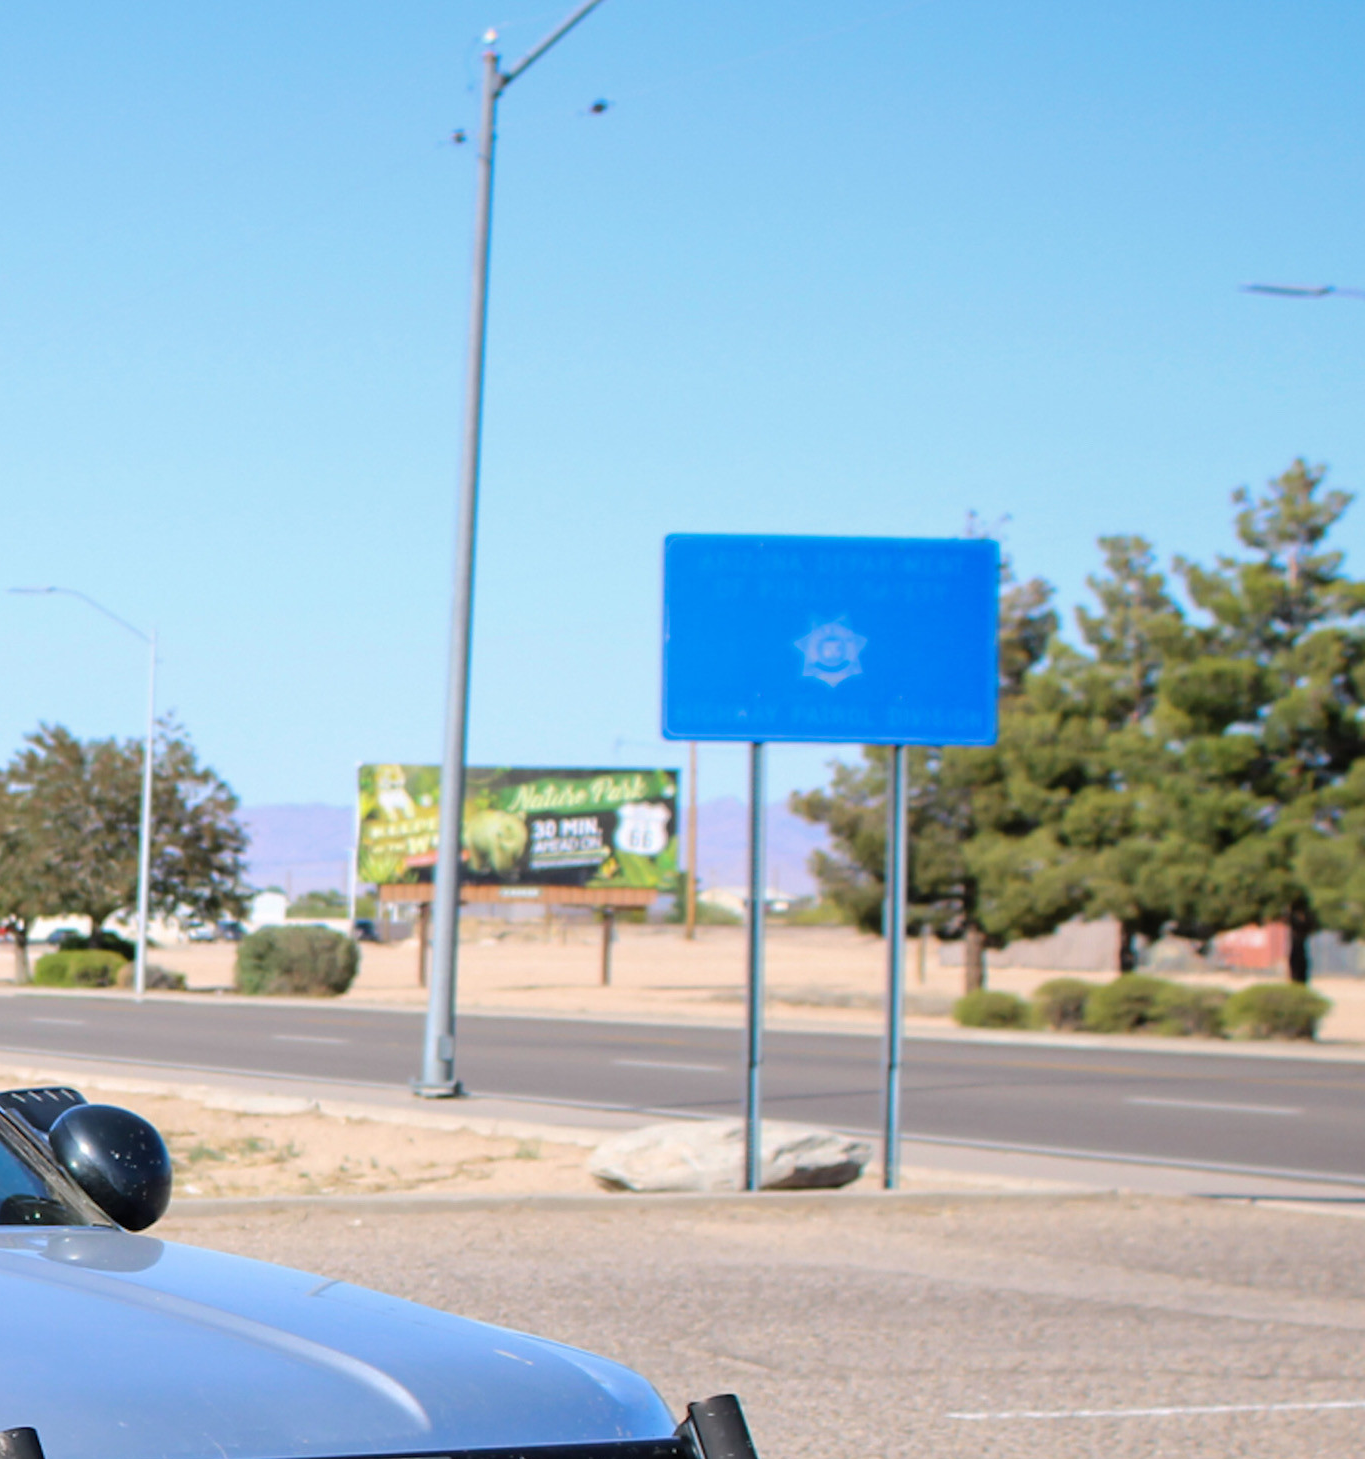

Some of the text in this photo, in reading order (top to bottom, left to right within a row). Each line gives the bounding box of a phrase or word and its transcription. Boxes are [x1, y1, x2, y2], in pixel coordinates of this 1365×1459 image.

[507, 774, 647, 812] Nature Park
[532, 819, 557, 840] 30
[629, 830, 653, 849] 66
